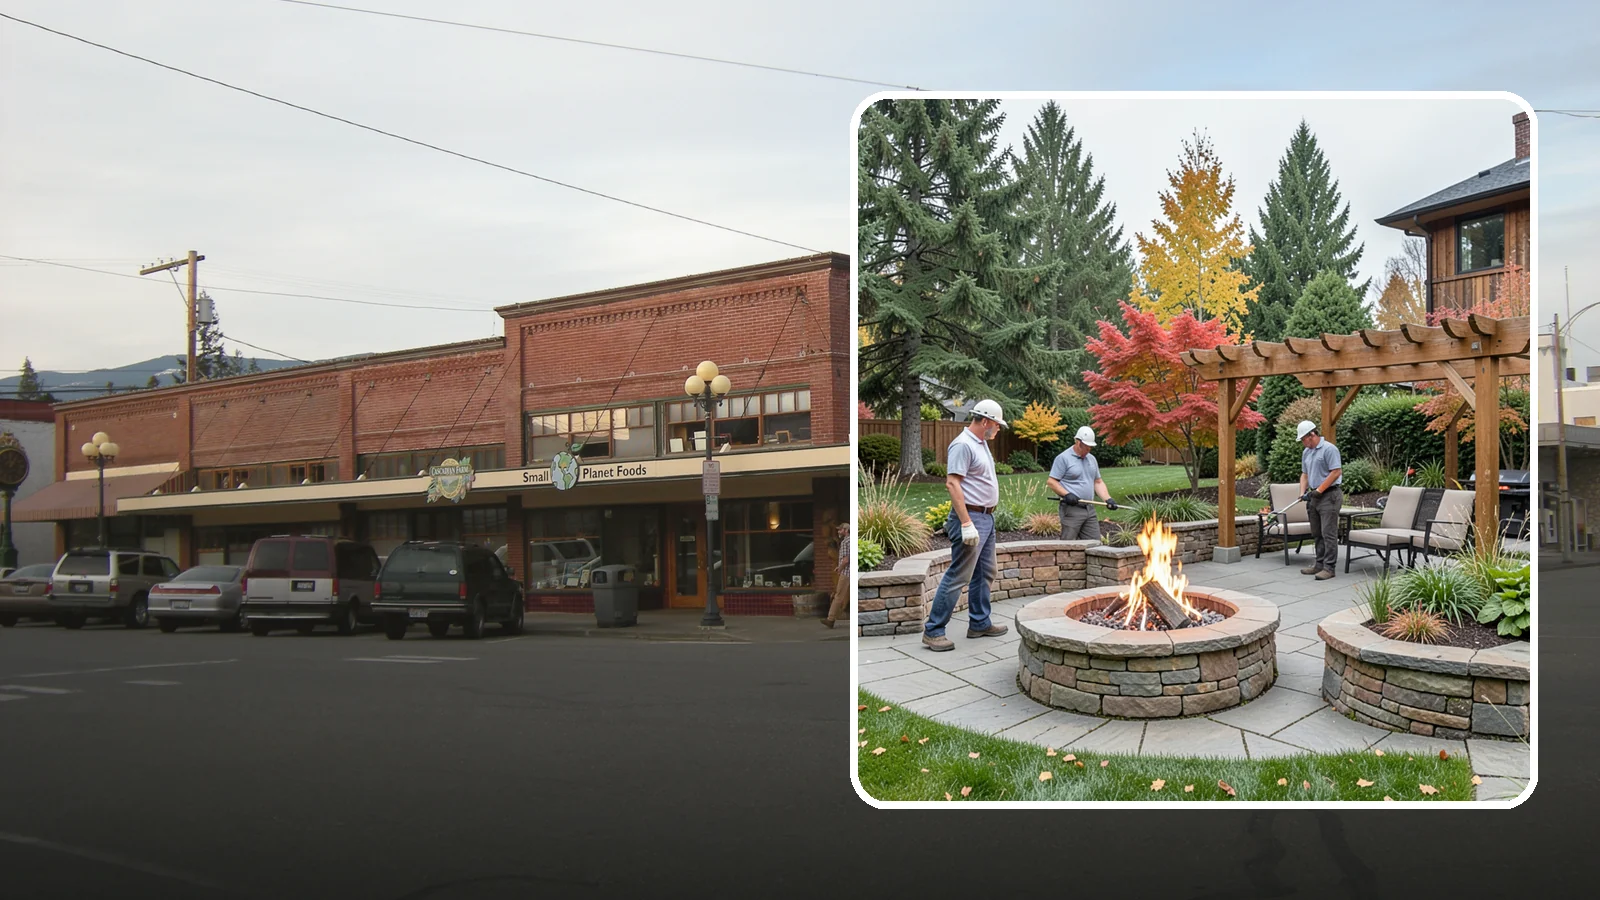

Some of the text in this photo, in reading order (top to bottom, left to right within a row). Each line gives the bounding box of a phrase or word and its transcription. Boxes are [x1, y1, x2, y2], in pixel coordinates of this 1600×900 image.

[523, 464, 647, 483] Small Planet Foods
